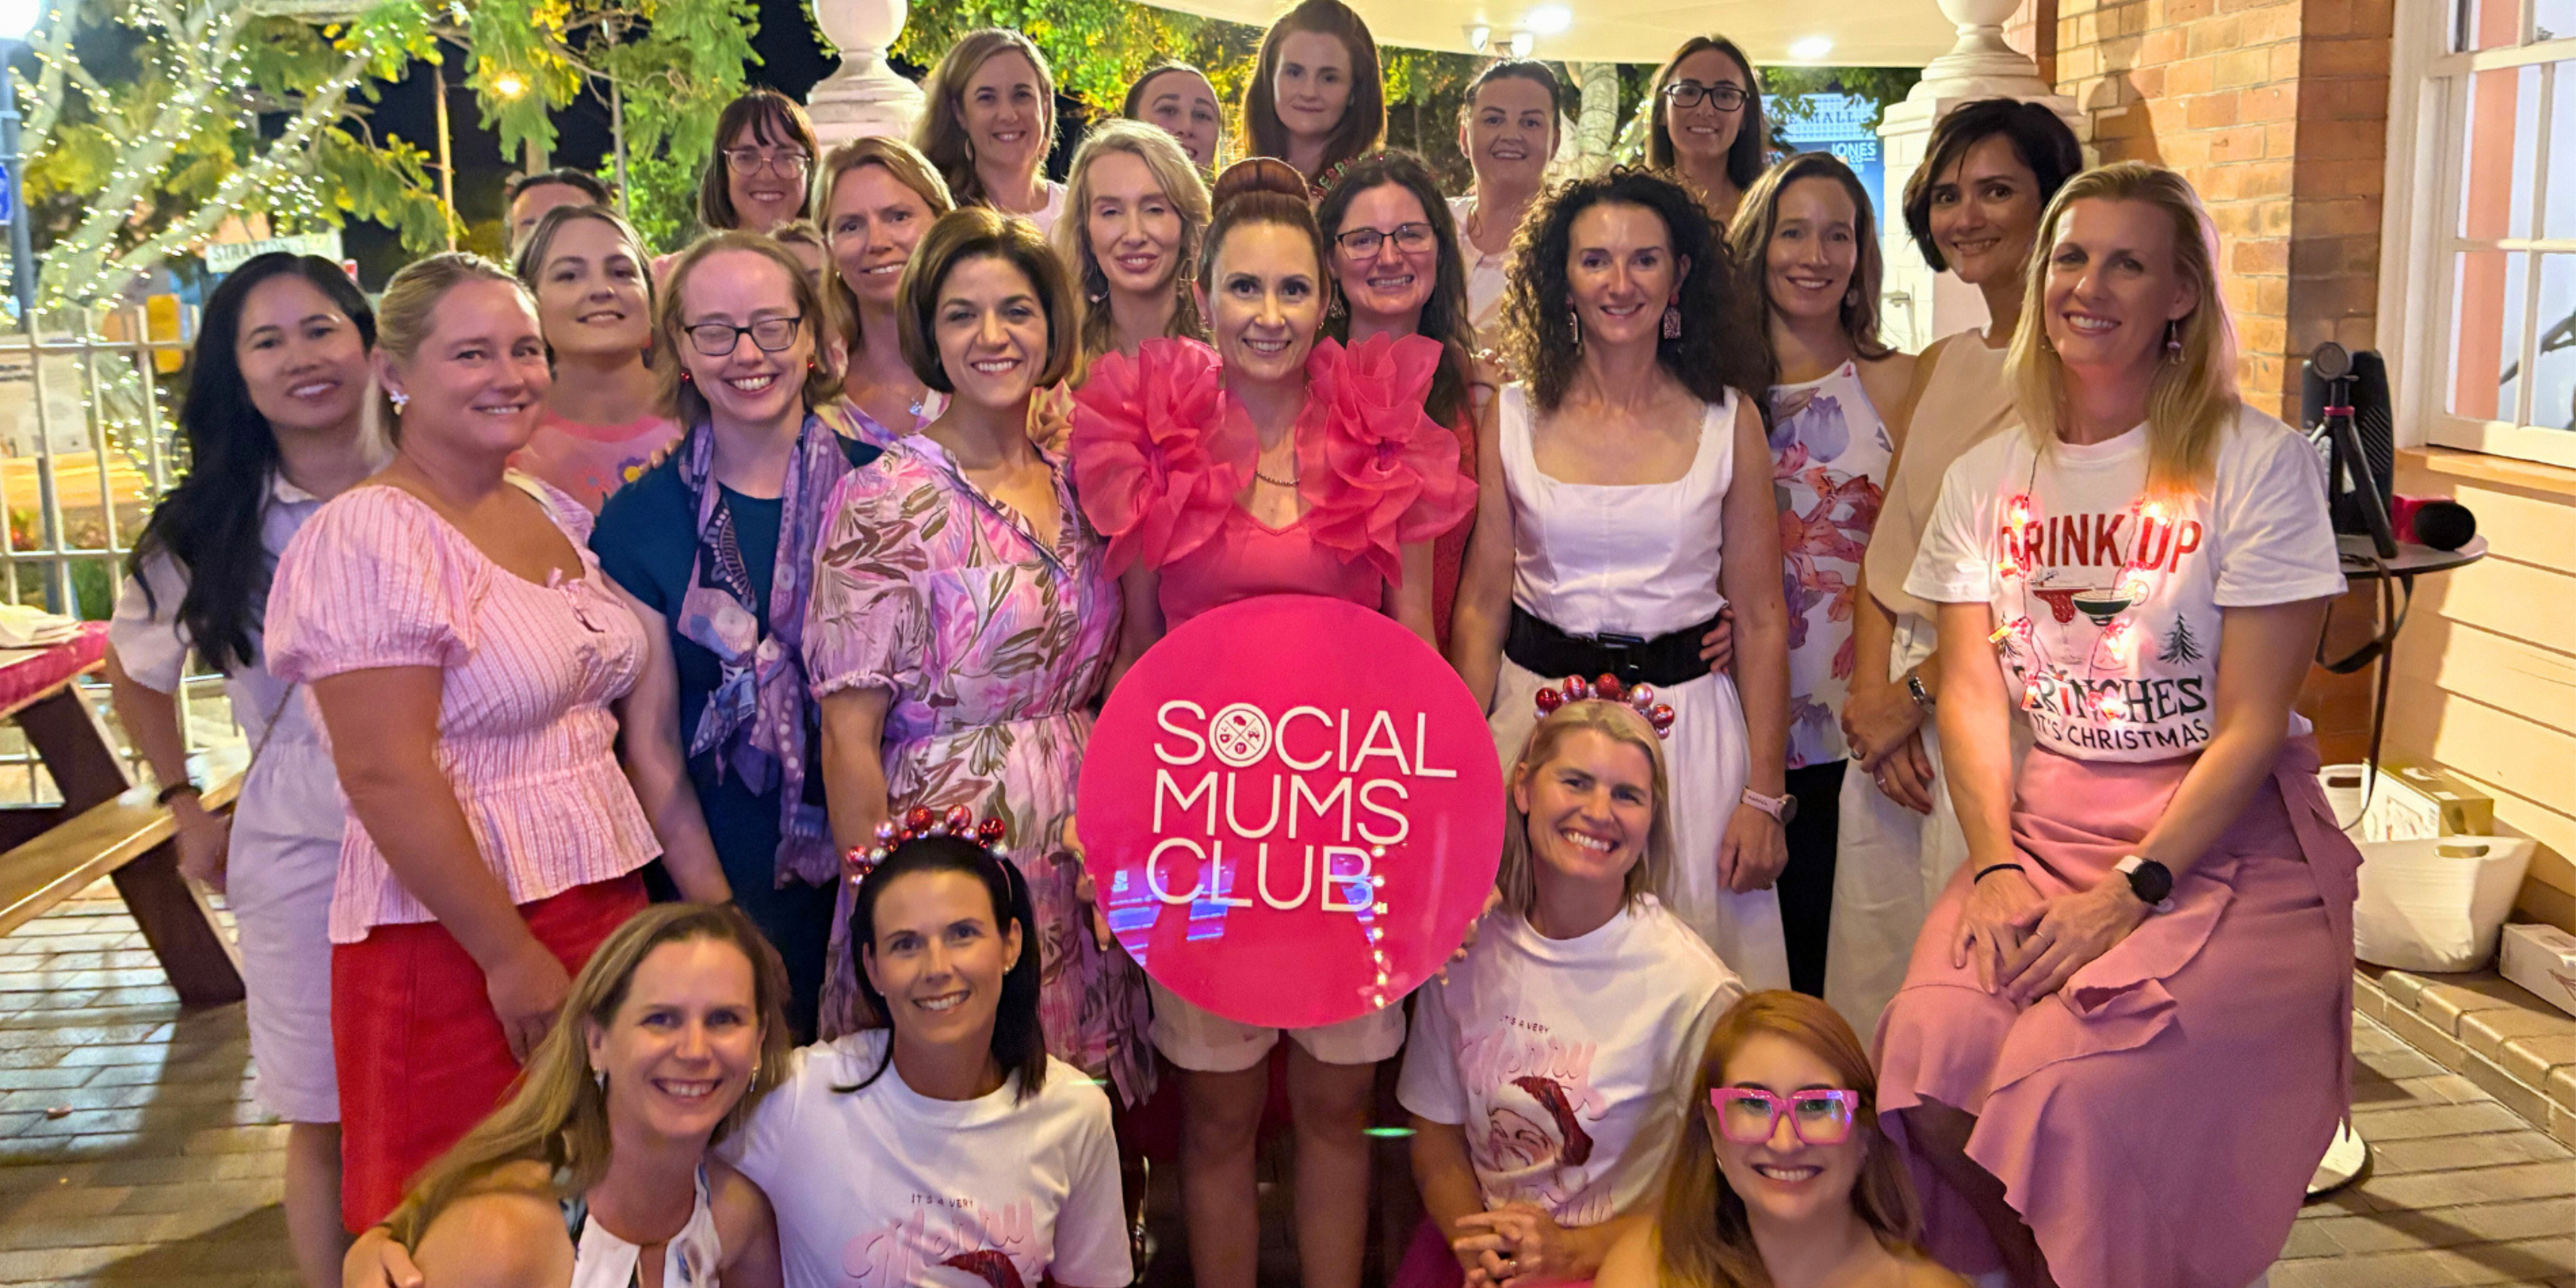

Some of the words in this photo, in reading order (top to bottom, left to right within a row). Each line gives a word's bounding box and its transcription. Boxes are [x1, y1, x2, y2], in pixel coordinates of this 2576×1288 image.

[2001, 514, 2126, 572] DRINK
[2136, 517, 2202, 574] UP
[1153, 699, 1457, 778] SOCIAL
[2032, 713, 2062, 741] IT'S
[2068, 718, 2209, 749] CHRISTMAS
[1153, 768, 1409, 845] MUMS
[1145, 837, 1374, 913] CLUB
[949, 1198, 973, 1209] VERY
